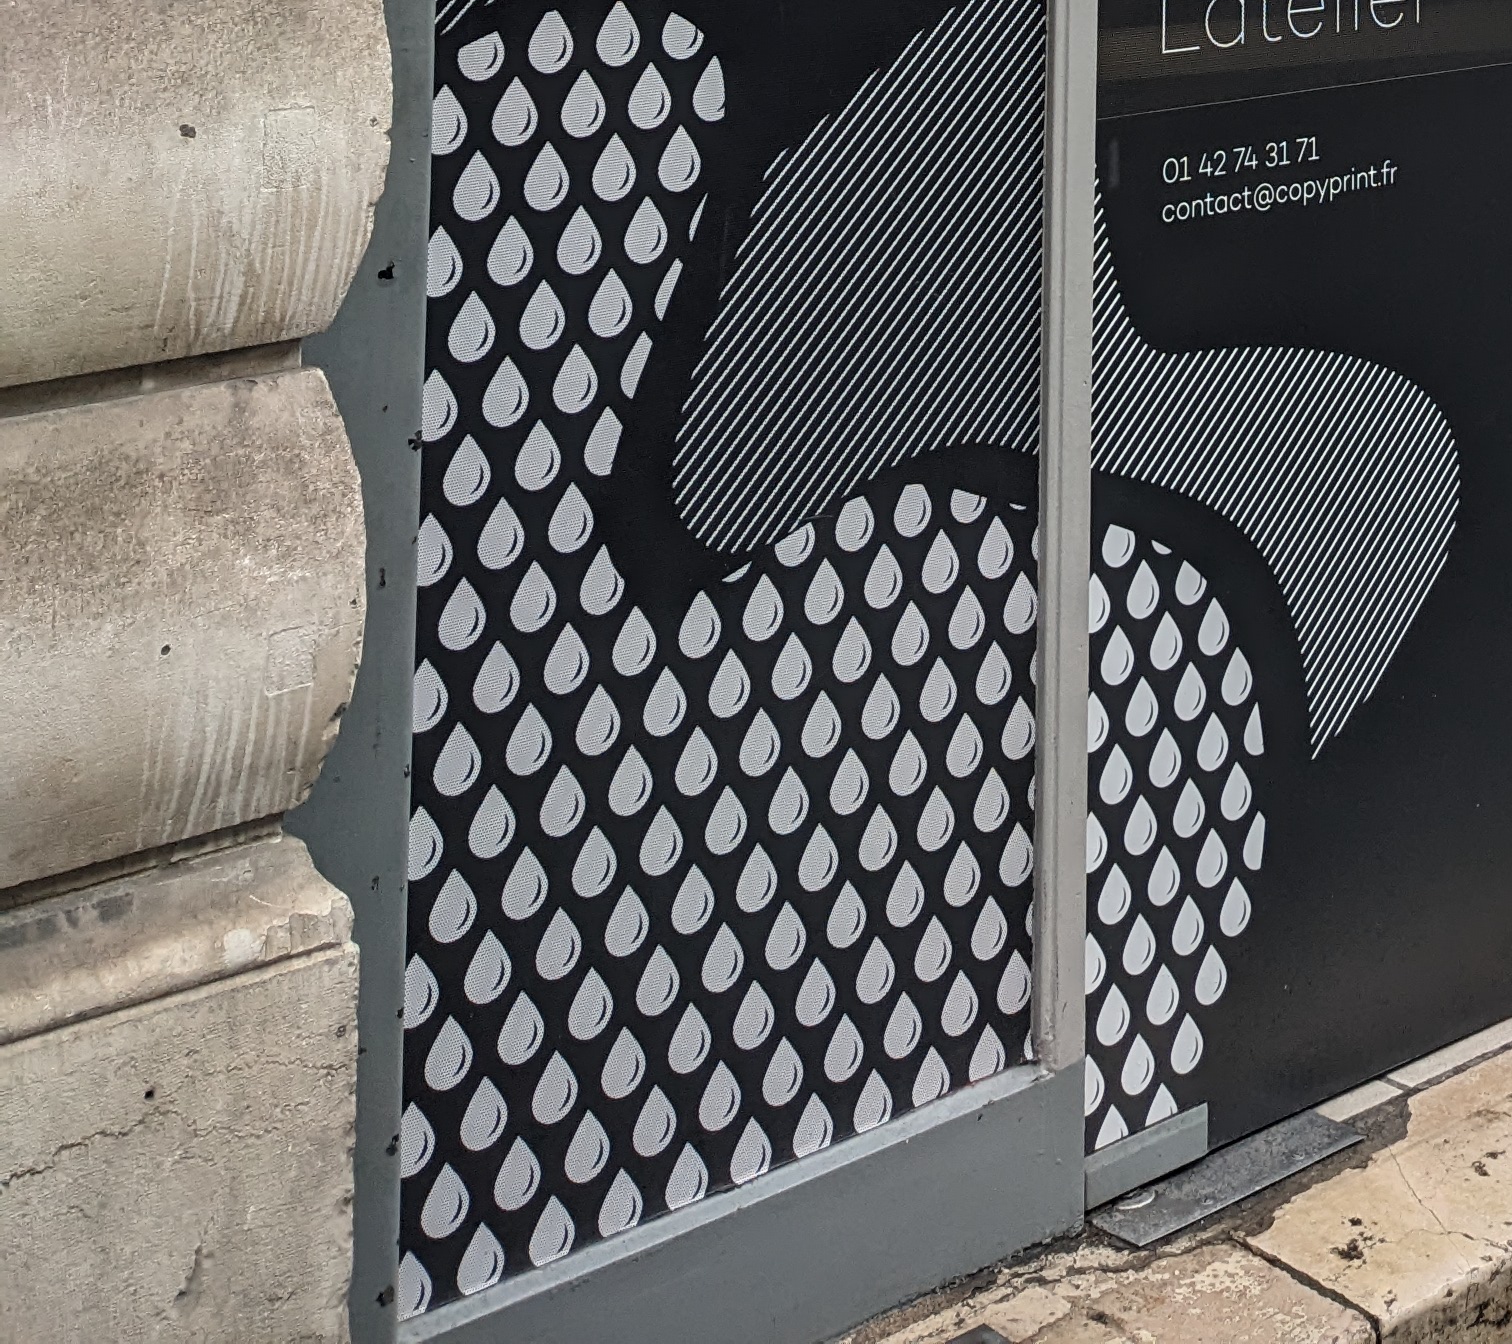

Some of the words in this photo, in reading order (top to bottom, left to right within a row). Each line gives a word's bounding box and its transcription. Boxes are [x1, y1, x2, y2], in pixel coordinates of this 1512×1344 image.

[1162, 157, 1192, 184] 01
[1199, 151, 1227, 177] 42
[1233, 146, 1259, 173] 74
[1265, 141, 1291, 168] 31
[1296, 137, 1320, 162] 71
[1162, 160, 1398, 223] contact@copyprint.fr
